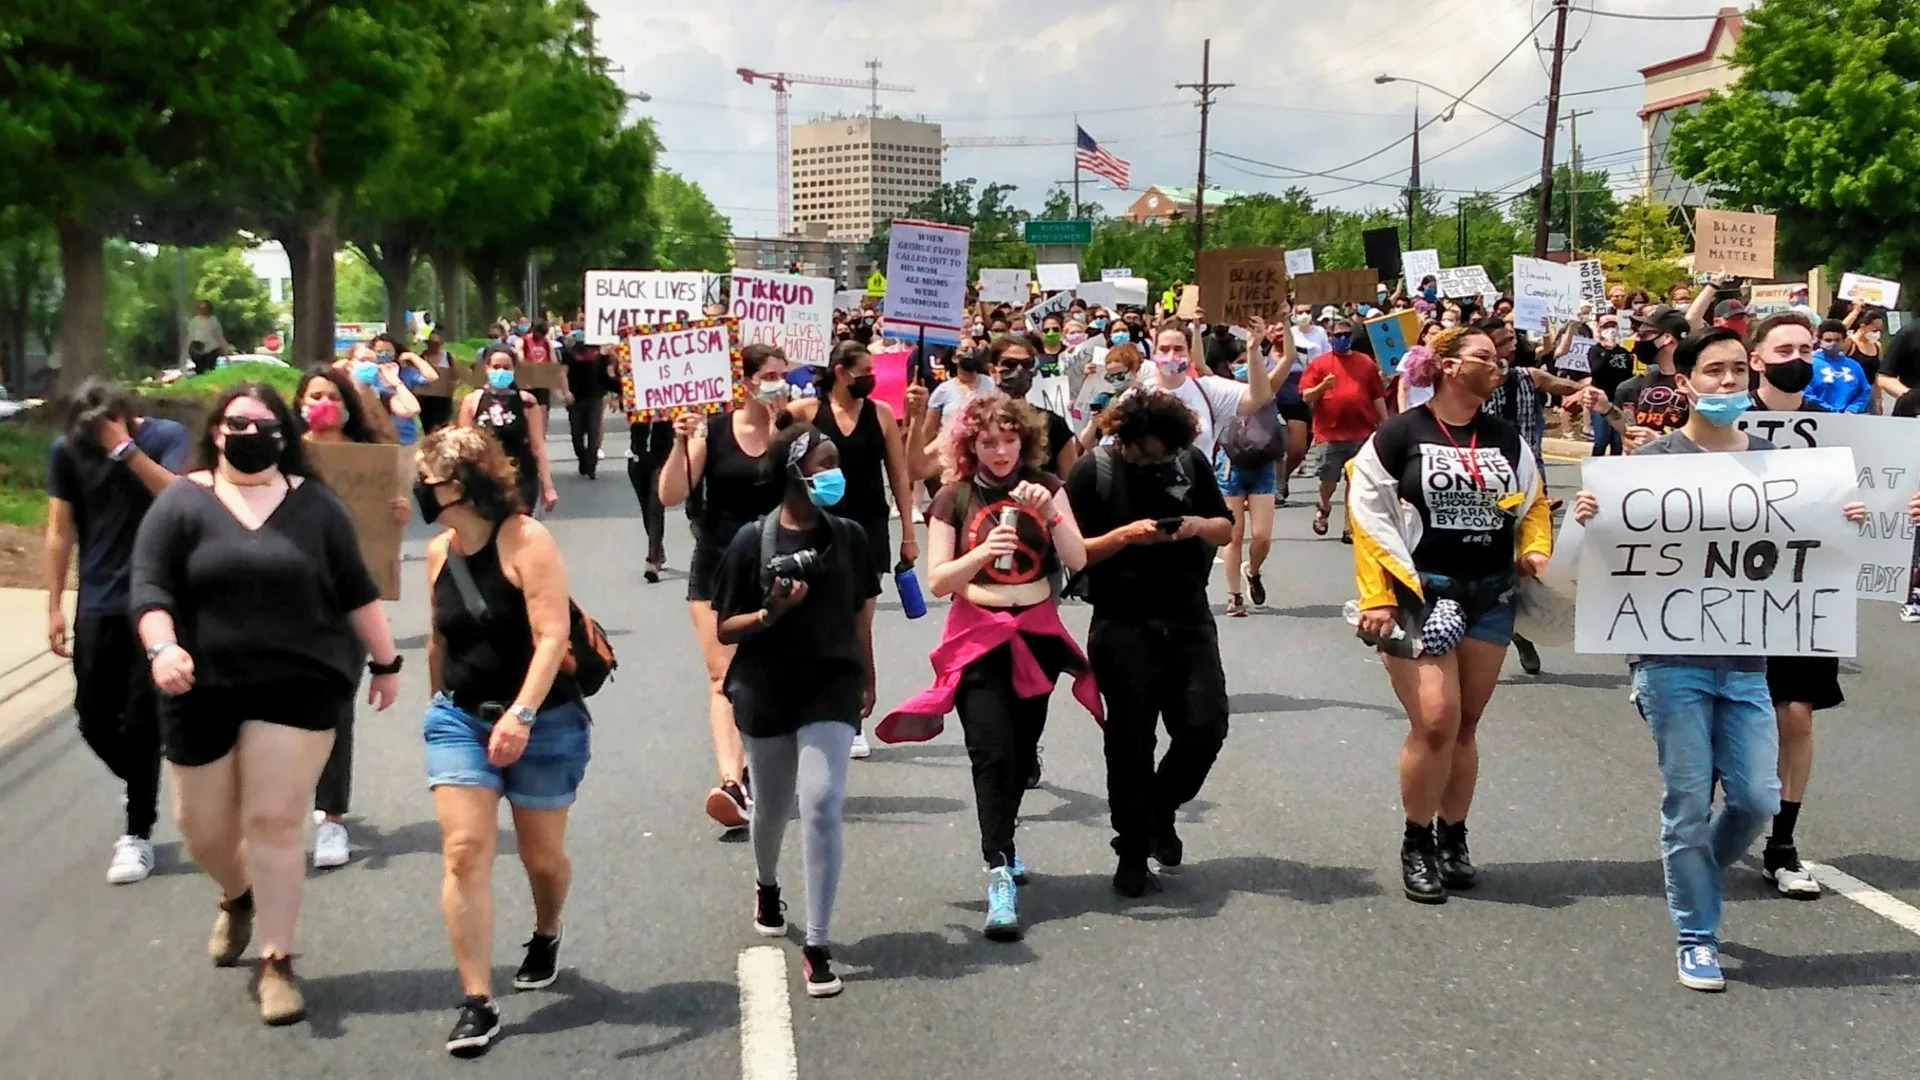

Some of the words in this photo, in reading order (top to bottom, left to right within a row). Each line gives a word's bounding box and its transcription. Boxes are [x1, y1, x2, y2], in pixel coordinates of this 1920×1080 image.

[1714, 221, 1756, 235] BLACK
[918, 233, 944, 243] WHEN
[1714, 236, 1753, 247] LIVES
[897, 241, 931, 253] GEORGE
[933, 245, 962, 256] FLOYD
[1709, 249, 1757, 262] MATTER
[895, 252, 928, 263] CALLED
[929, 256, 947, 266] OUT
[950, 259, 962, 268] TO
[900, 264, 914, 272] HIS
[916, 265, 937, 275] MOM
[1230, 268, 1278, 284] BLACK
[1580, 262, 1590, 278] NO
[1591, 261, 1600, 276] NO
[596, 279, 647, 299] BLACK
[655, 281, 696, 302] LIVES
[733, 276, 814, 305] Tikkun
[922, 278, 949, 287] MOMS
[914, 287, 939, 297] WERE
[1230, 285, 1275, 300] LIVES
[1581, 280, 1594, 303] PEA
[1592, 277, 1607, 314] JUSTICE
[900, 297, 950, 309] SUMMONED
[1225, 301, 1280, 322] MATTER
[786, 323, 822, 341] LIVES
[640, 330, 723, 362] RACISM
[784, 337, 824, 361] MATTER
[659, 364, 670, 380] IS
[684, 361, 693, 376] A
[1567, 359, 1587, 369] FOR
[645, 376, 725, 407] PANDEMIC
[1429, 456, 1451, 470] IS
[1456, 460, 1509, 473] THE
[1428, 472, 1510, 493] ONLY
[1429, 492, 1476, 500] THING
[1431, 500, 1490, 508] SHOULD
[1622, 478, 1798, 534] COLOR
[1436, 515, 1457, 525] BY
[1610, 542, 1683, 577] IS
[1704, 539, 1821, 583] NOT
[1606, 593, 1648, 642] A
[1660, 586, 1840, 653] CRIME
